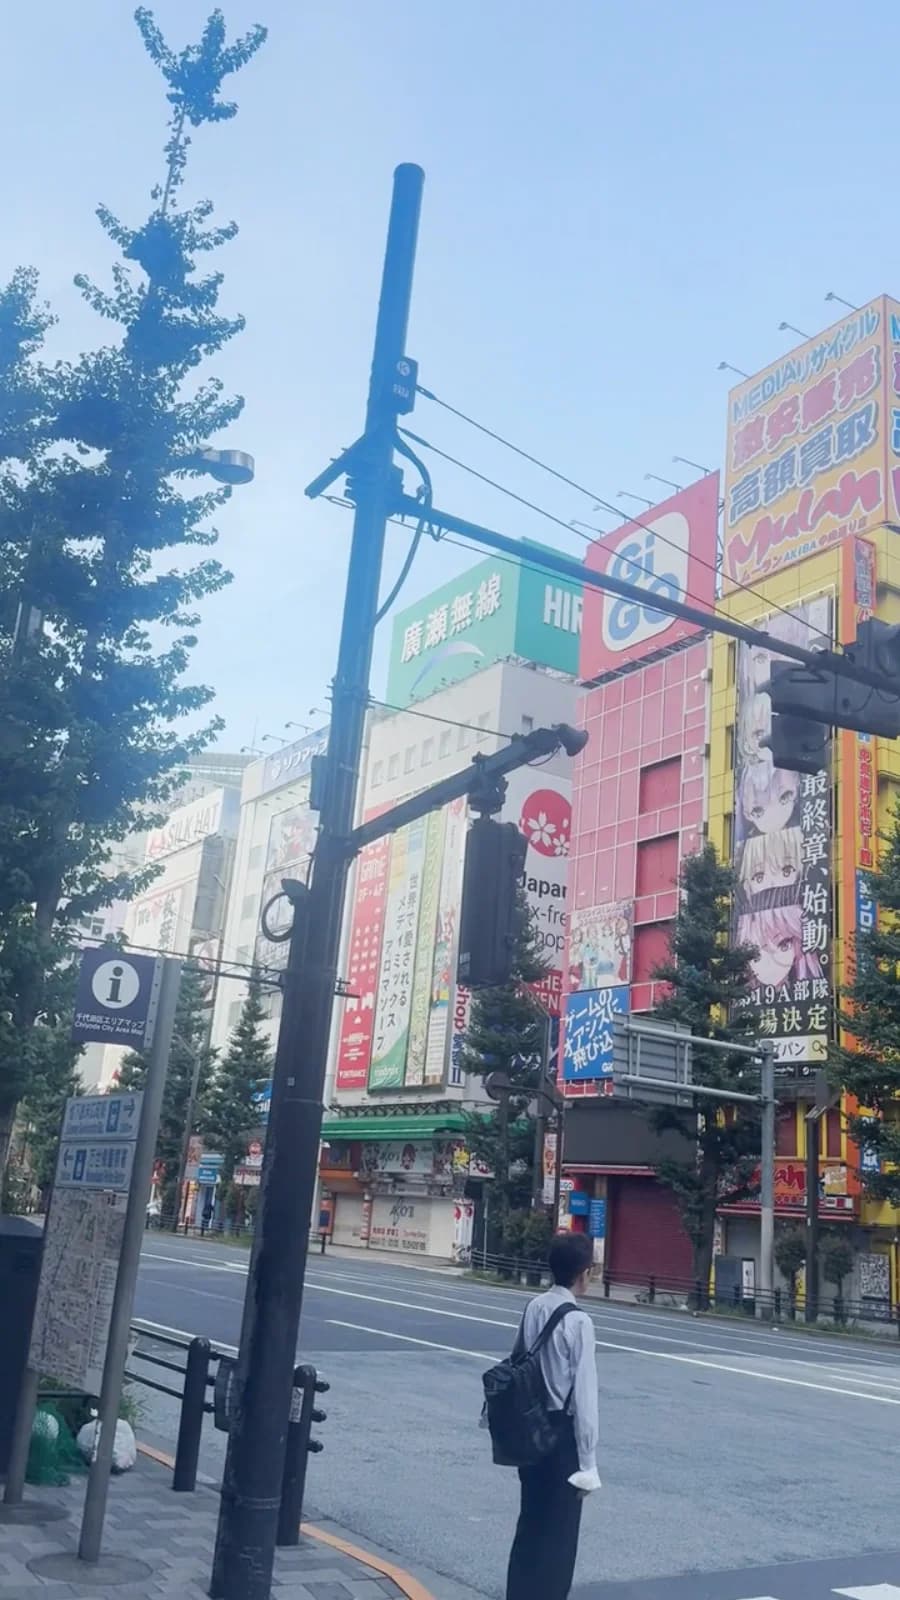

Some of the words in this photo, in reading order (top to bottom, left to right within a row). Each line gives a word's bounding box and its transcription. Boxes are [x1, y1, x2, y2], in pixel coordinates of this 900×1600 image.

[728, 400, 878, 526] 高額買取
[101, 1024, 115, 1033] City
[115, 1026, 130, 1034] Area
